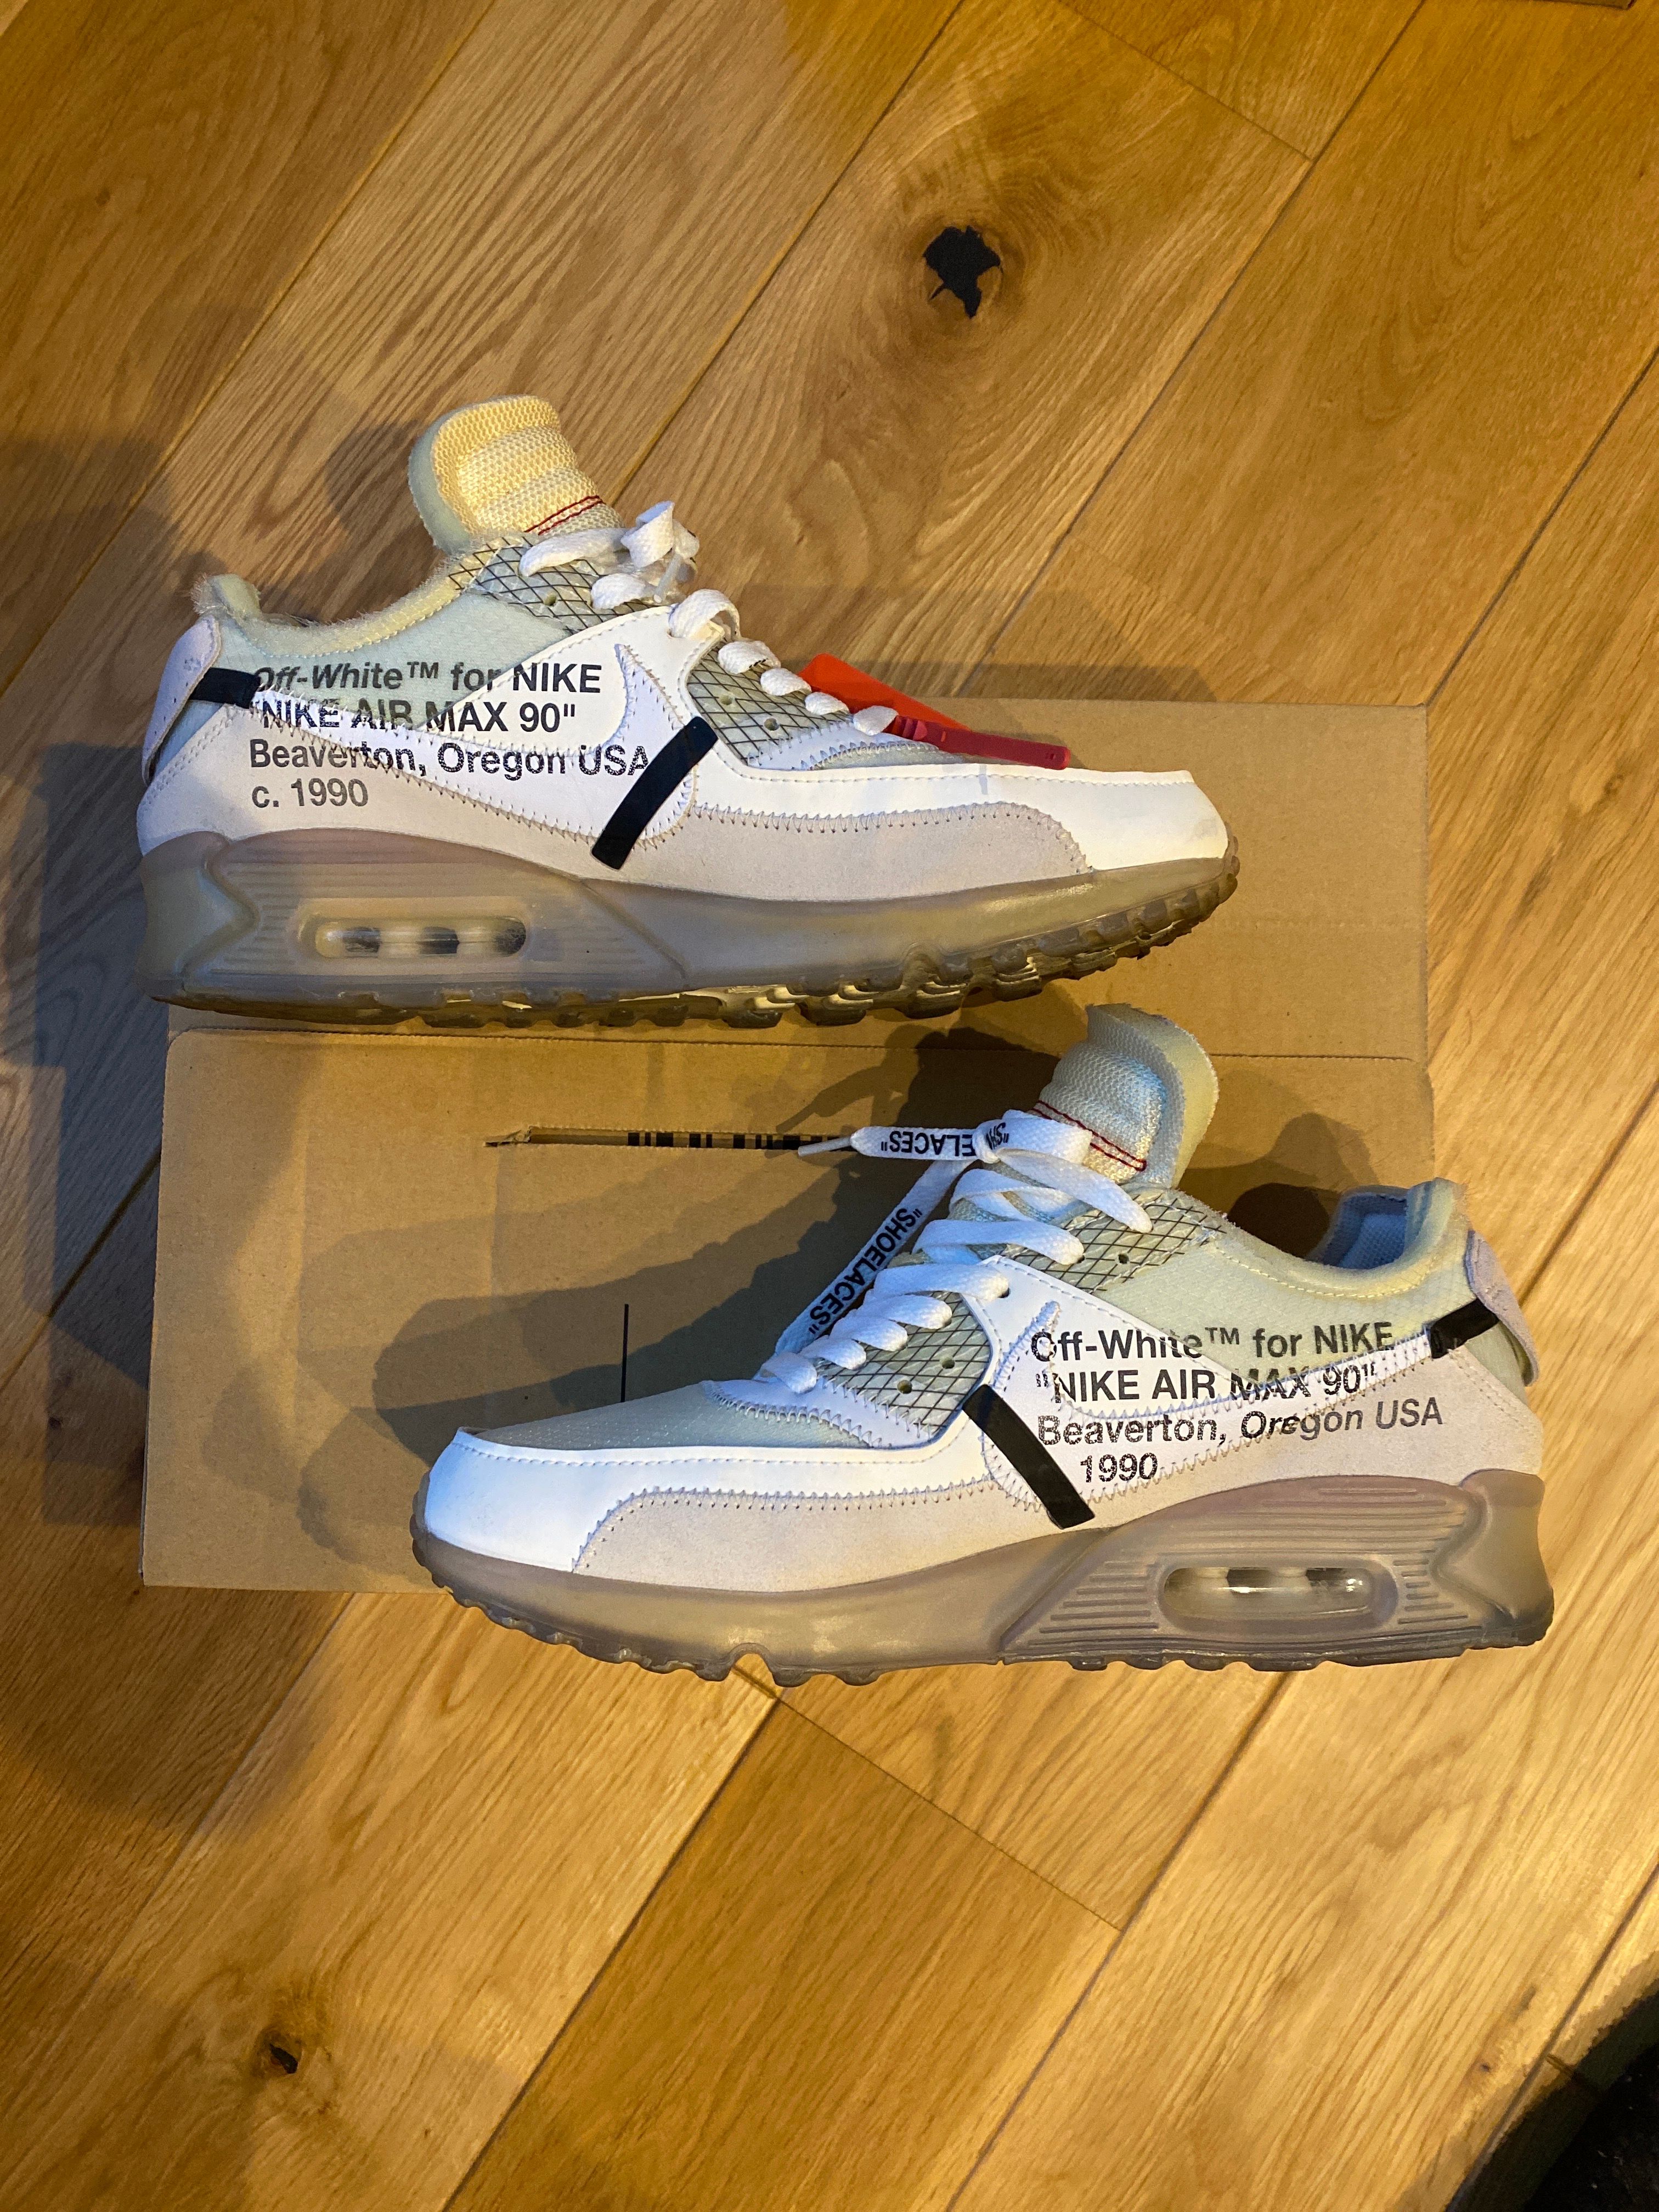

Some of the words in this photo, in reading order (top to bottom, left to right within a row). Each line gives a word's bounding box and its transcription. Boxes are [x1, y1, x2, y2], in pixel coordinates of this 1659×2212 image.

[450, 662, 502, 691] for
[513, 662, 602, 693] NIKE
[351, 698, 413, 730] AIR
[425, 701, 509, 732] MAX
[519, 702, 575, 733] 90"
[250, 738, 427, 777] Beaverton,
[437, 742, 566, 781] Oregon
[578, 744, 650, 776] USA
[251, 786, 280, 808] c.
[290, 777, 369, 807] 1990
[808, 1208, 923, 1334] "SHOELACES"
[1252, 1328, 1302, 1358] for
[1314, 1321, 1393, 1355] NIKE
[1035, 1370, 1140, 1403] "NIKE
[1152, 1369, 1216, 1400] AIR
[1229, 1365, 1311, 1402] MAX
[1322, 1362, 1375, 1396] 90"
[1037, 1414, 1227, 1448] Beaverton,
[1240, 1409, 1364, 1442] Oregon
[1375, 1397, 1443, 1430] USA
[1080, 1452, 1159, 1483] 1990
